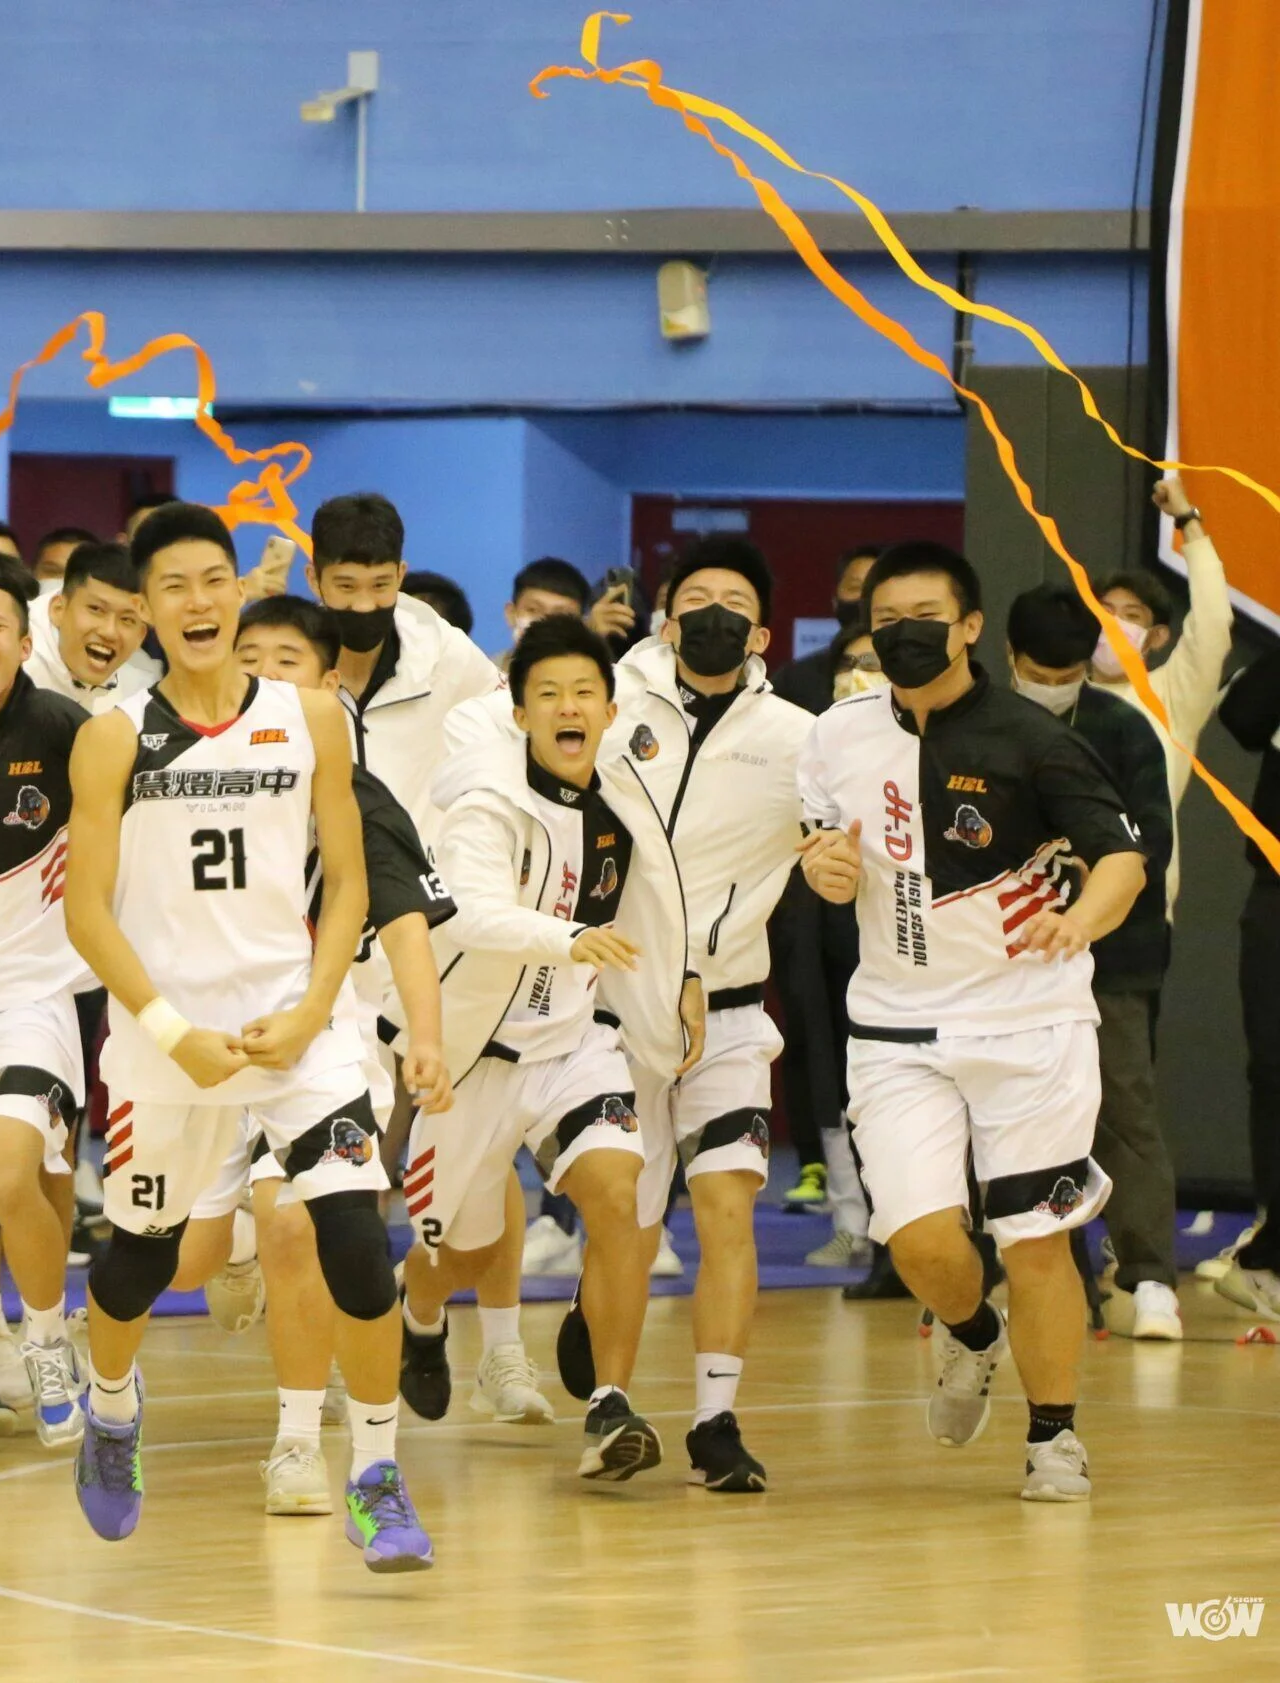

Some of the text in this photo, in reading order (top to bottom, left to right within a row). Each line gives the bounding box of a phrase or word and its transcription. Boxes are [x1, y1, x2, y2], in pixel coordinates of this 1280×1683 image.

[250, 728, 289, 745] HBL
[8, 760, 43, 776] HBL
[133, 767, 301, 803] 慧燈高中
[947, 774, 988, 794] HBL
[190, 827, 248, 891] 21
[419, 871, 450, 901] 13
[894, 871, 910, 956] BASKETBALL
[908, 871, 928, 967] HIGH SCHOOL
[132, 1173, 166, 1210] 21
